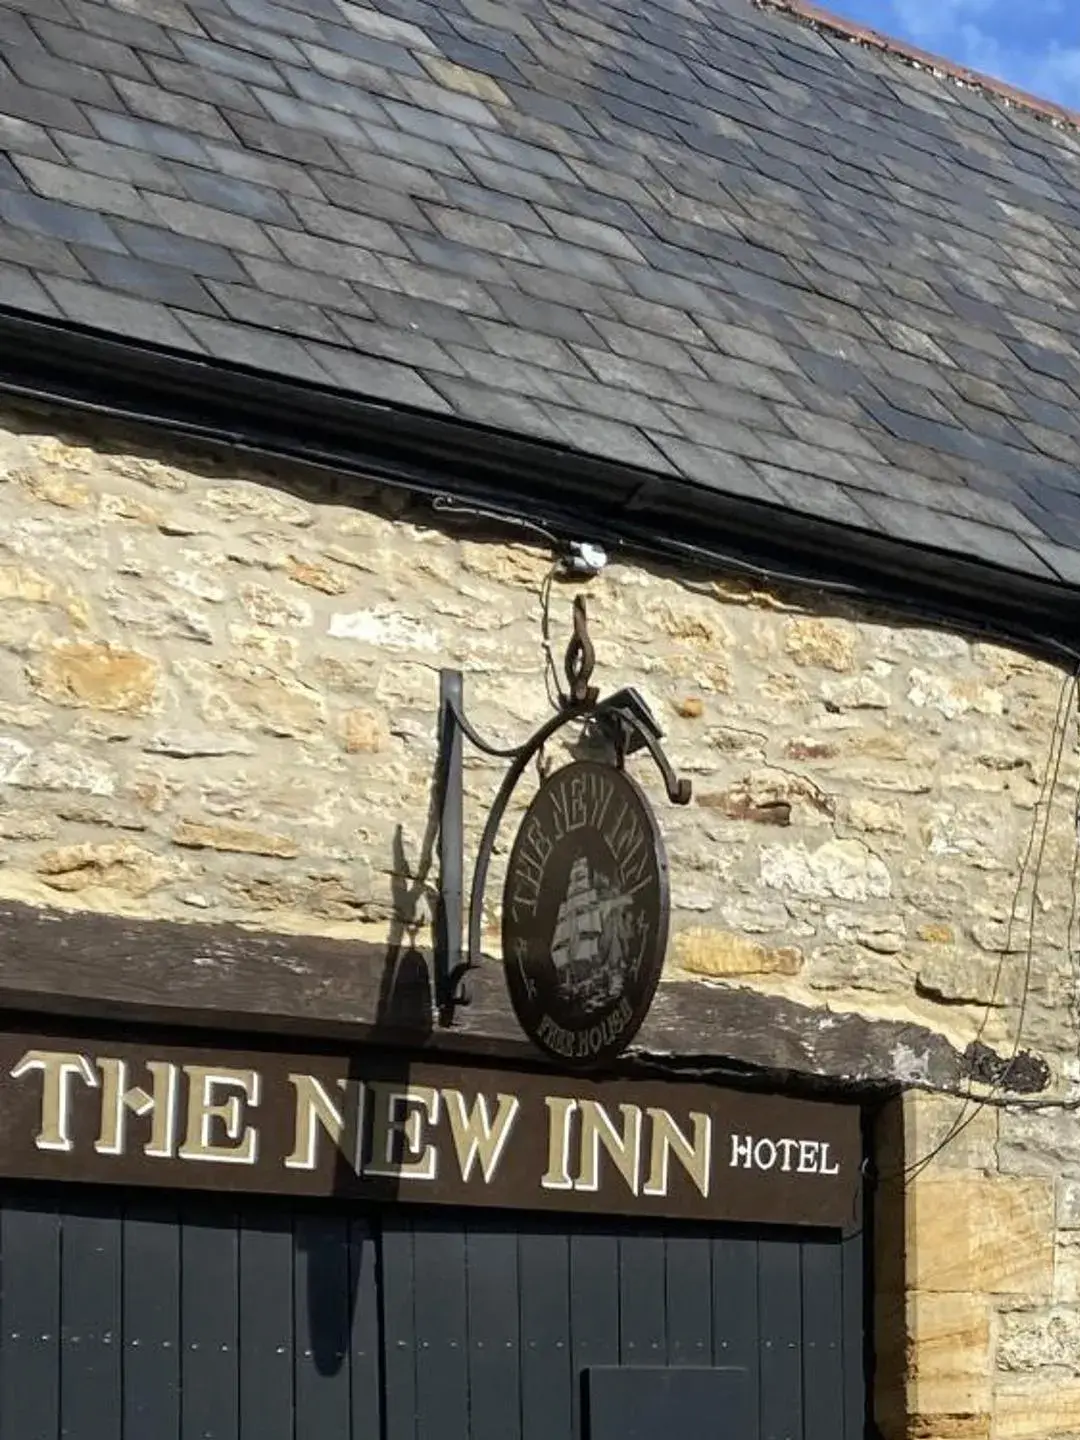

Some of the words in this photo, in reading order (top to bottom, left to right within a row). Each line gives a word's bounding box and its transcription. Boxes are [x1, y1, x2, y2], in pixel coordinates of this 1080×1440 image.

[511, 816, 553, 923] THE
[550, 773, 615, 841] NEW
[604, 801, 653, 896] INN
[11, 1050, 260, 1164] THE
[285, 1074, 519, 1184] NEW
[541, 1096, 711, 1198] INN
[729, 1134, 840, 1176] HOTEL
